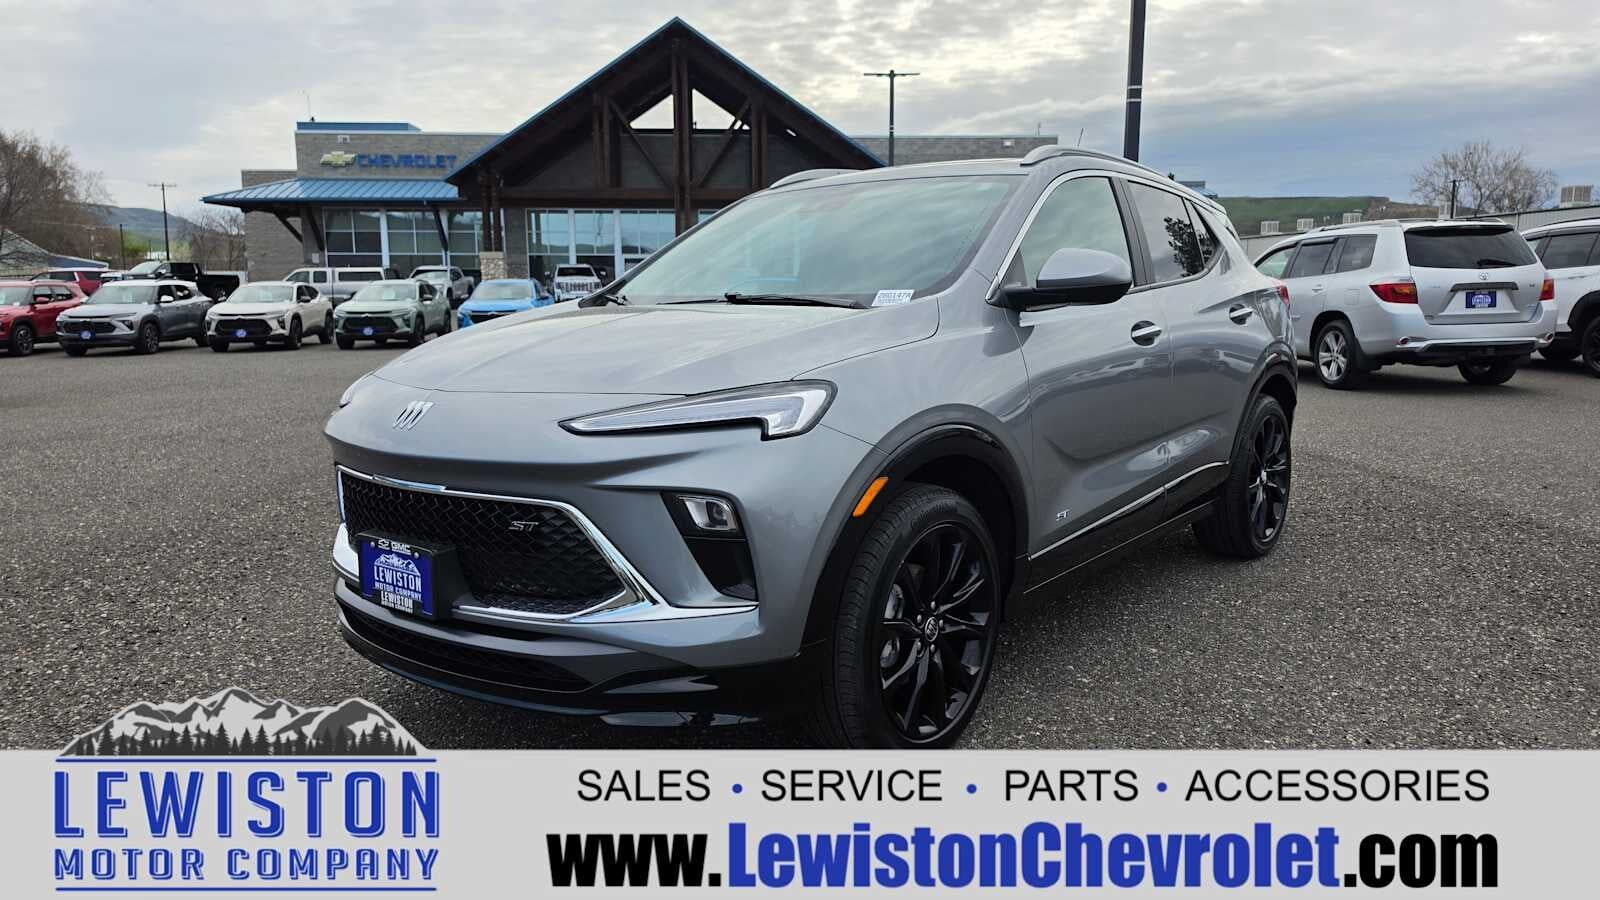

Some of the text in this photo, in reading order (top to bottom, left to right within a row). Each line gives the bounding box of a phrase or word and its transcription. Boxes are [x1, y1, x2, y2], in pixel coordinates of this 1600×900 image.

[357, 153, 457, 168] CHEVROLET
[509, 520, 539, 531] ST
[391, 542, 411, 553] GMC
[374, 565, 422, 593] LEWISTON
[374, 581, 422, 602] MOTOR COMPANY
[381, 590, 413, 609] LEWISTON
